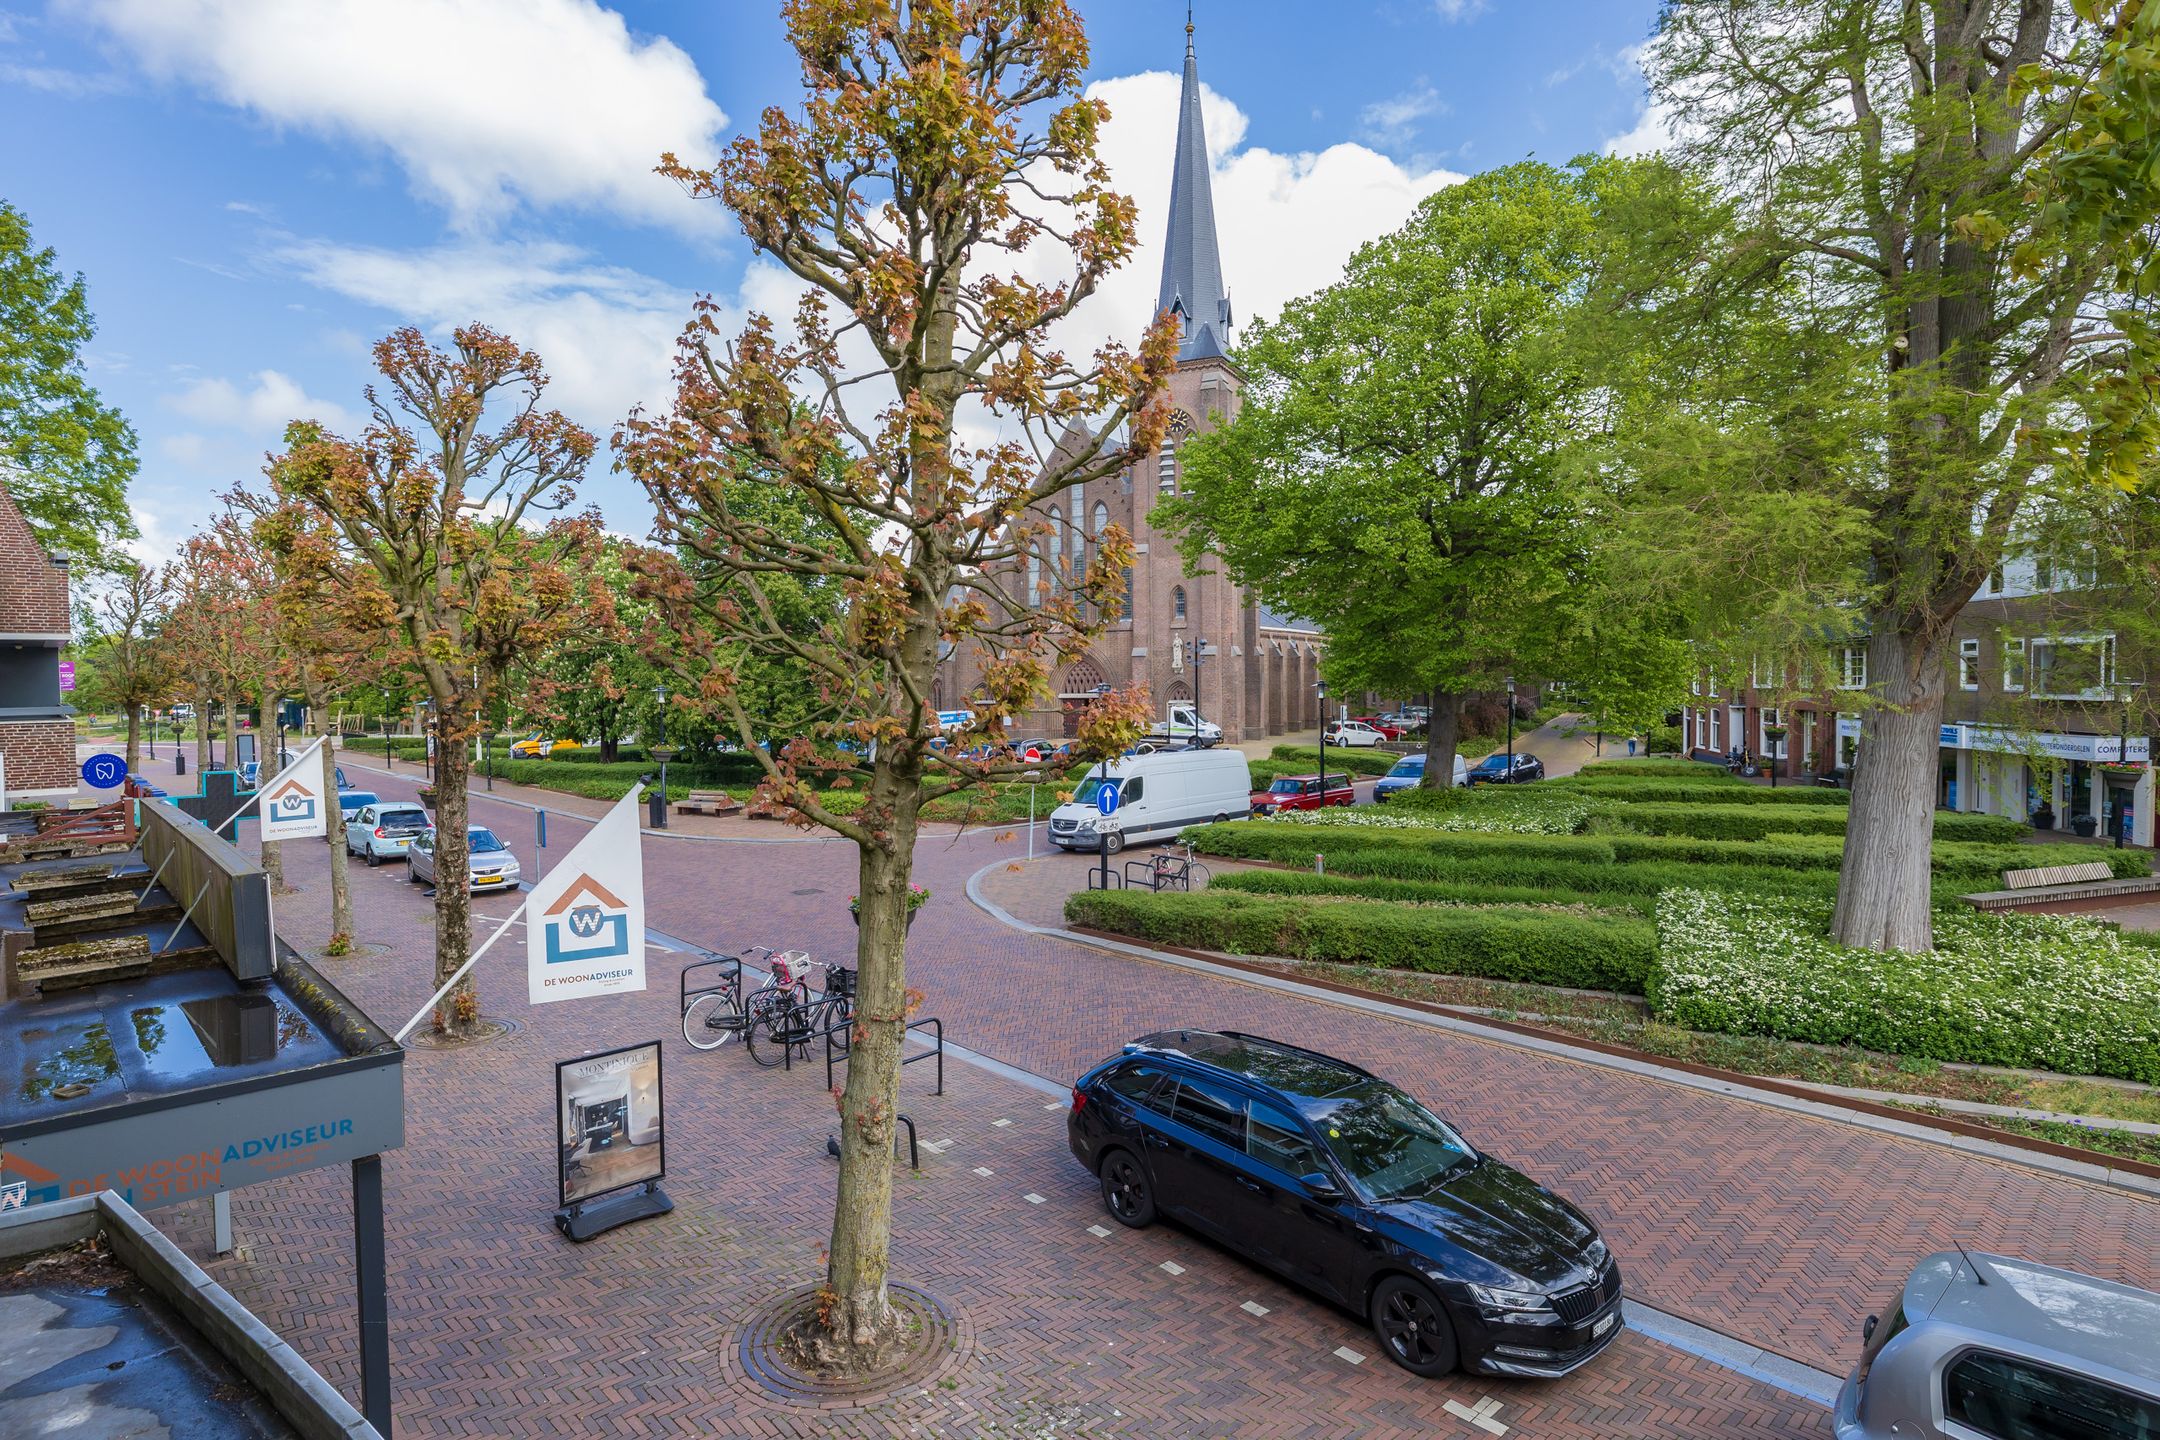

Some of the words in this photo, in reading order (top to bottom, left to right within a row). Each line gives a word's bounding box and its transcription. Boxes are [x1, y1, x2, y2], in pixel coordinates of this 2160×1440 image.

[285, 798, 300, 808] W
[572, 912, 600, 933] W
[544, 978, 557, 987] DE
[143, 1168, 222, 1201] STEIN
